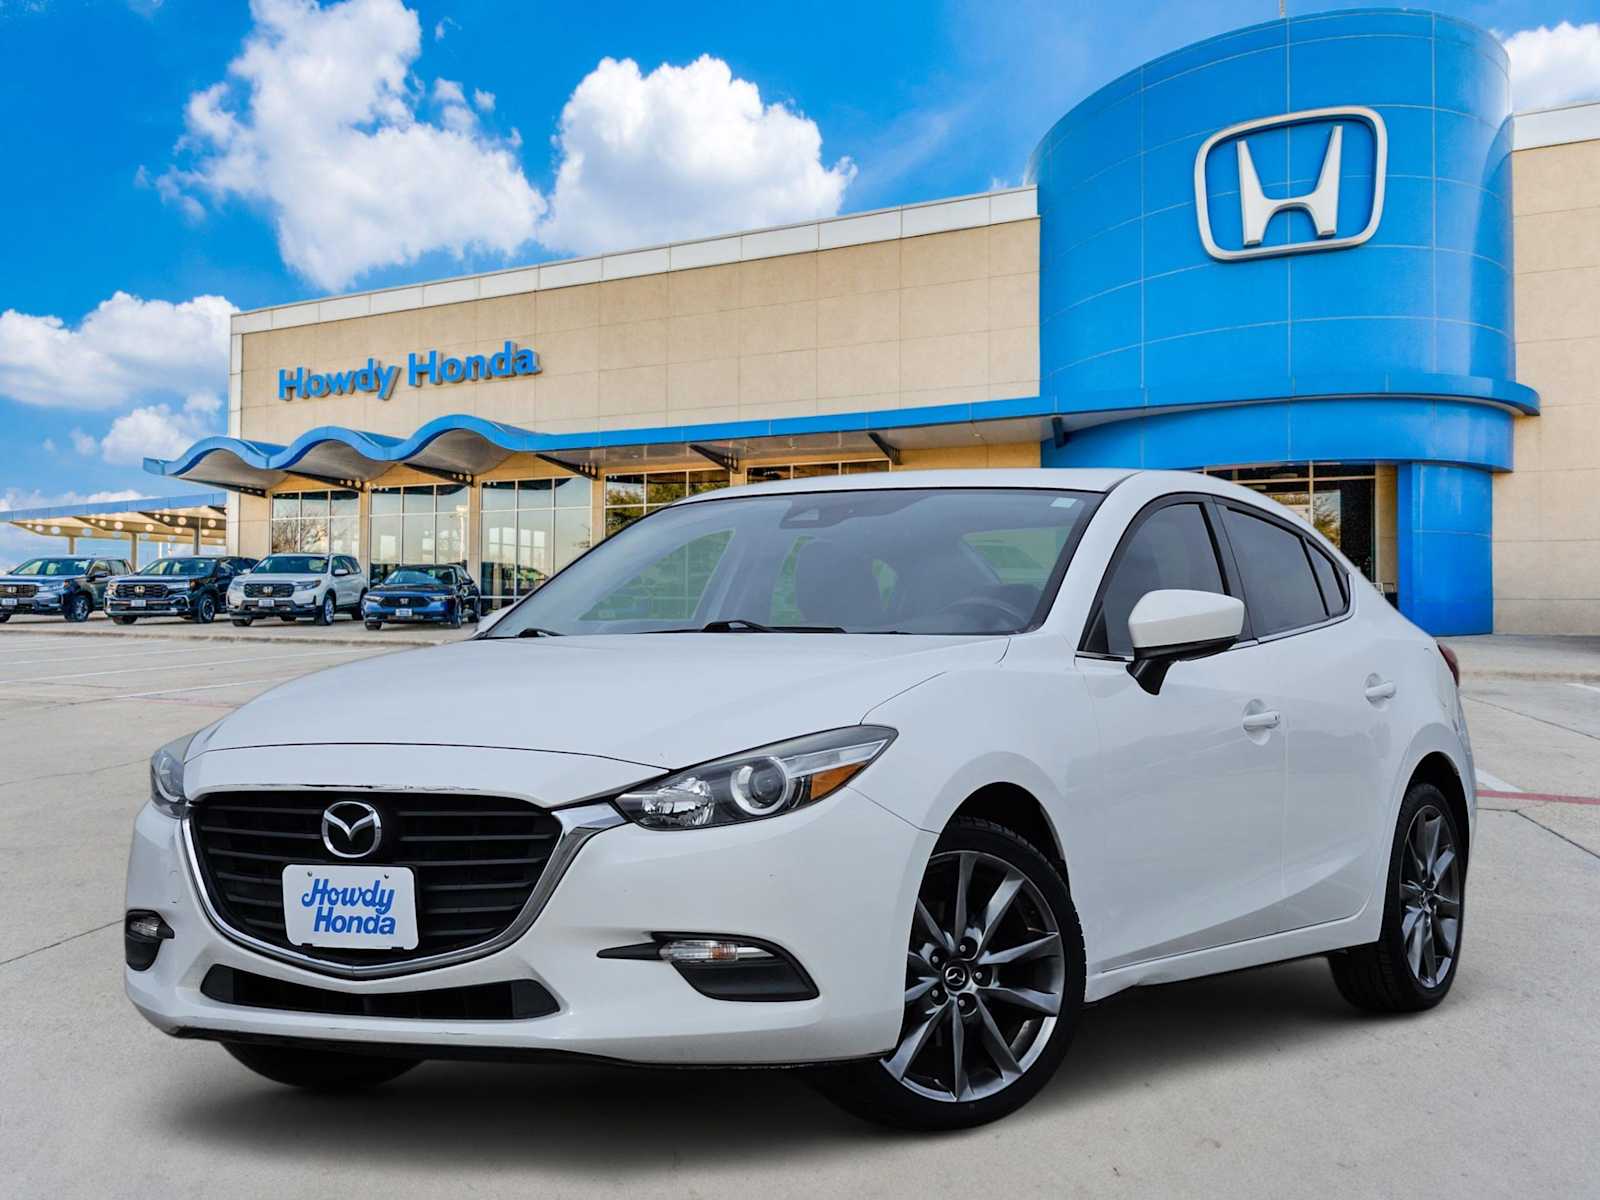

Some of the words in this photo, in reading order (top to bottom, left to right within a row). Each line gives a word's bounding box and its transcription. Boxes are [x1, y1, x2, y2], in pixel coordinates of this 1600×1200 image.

[278, 358, 401, 400] Howdy
[408, 340, 542, 387] Honda
[301, 878, 395, 915] Howdy
[314, 906, 396, 934] Honda
